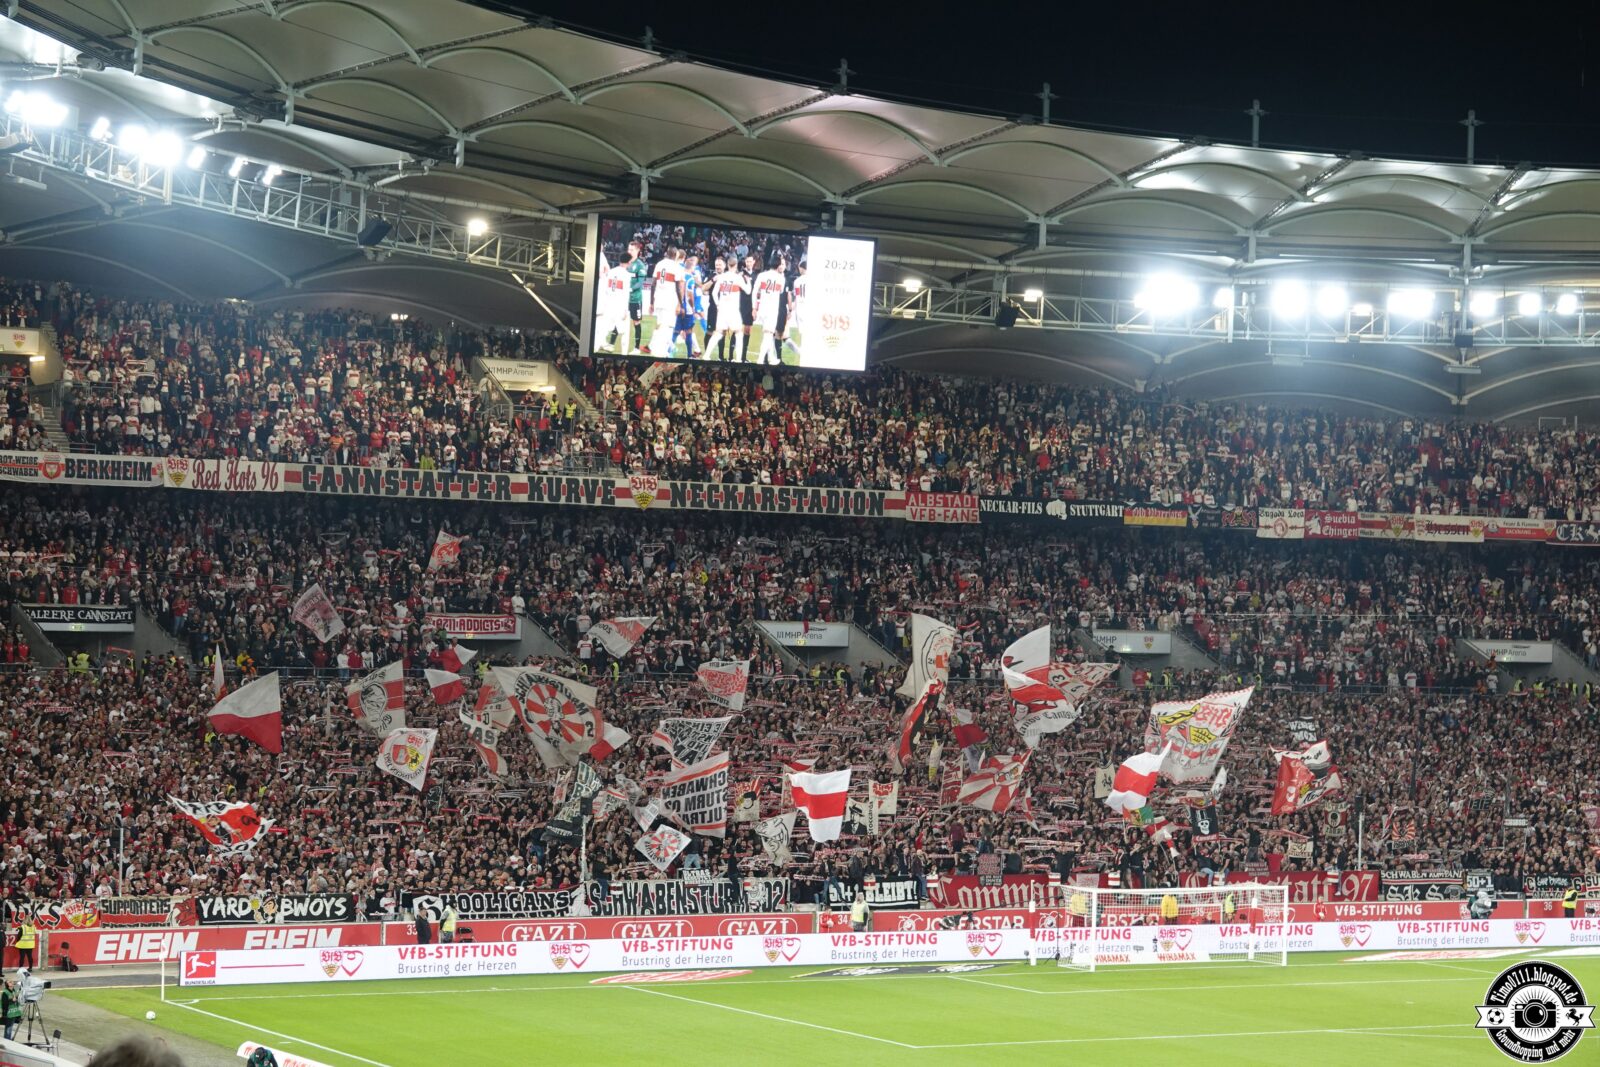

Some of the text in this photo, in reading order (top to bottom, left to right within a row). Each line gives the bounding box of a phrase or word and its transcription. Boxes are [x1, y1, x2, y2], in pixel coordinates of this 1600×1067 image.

[824, 259, 855, 271] 20:28
[65, 457, 152, 482] BERKHEIM
[192, 457, 279, 491] Red Hots 96
[302, 464, 512, 501] CANNSTATTER
[528, 474, 616, 507] KURVE
[669, 480, 886, 517] NECKARSTADION
[910, 507, 978, 522] VFB-FANS
[980, 498, 1124, 518] NECKAR-FILS STUTTGART
[1324, 512, 1356, 524] Suebia
[1425, 520, 1470, 537] Hessen
[24, 608, 132, 622] ALEERE CANNSTATT
[459, 618, 501, 631] ADDICTS
[785, 631, 801, 639] MHP
[1381, 869, 1428, 880] SCHWABEN
[1466, 876, 1493, 888] 50+1
[866, 880, 918, 904] BLEIBT!
[1341, 873, 1374, 902] 97
[102, 897, 171, 914] SUPPORTERS
[199, 897, 251, 919] YARD
[440, 890, 570, 915] HOOLIGANS
[1334, 903, 1423, 917] VfB-STIFTUNG
[837, 914, 849, 925] 34
[1219, 924, 1313, 938] VfB-TIFTUNG
[1397, 921, 1489, 934] VfB-STIFTUNG
[95, 931, 199, 961] EHEIM
[243, 927, 343, 951] EHEIM
[622, 937, 734, 954] VfB-STIFTUNG
[831, 932, 938, 948] VfB-STIFTUNG
[1263, 939, 1278, 949] der
[1397, 935, 1489, 947] Brustring der Herzen
[398, 943, 518, 960] VfB-STIFTUNG
[831, 948, 938, 961] Brustring der Herzen
[1098, 943, 1131, 953] Herzen
[398, 960, 518, 976] Brustring der Herzen
[622, 953, 734, 968] Brustring der Herzen
